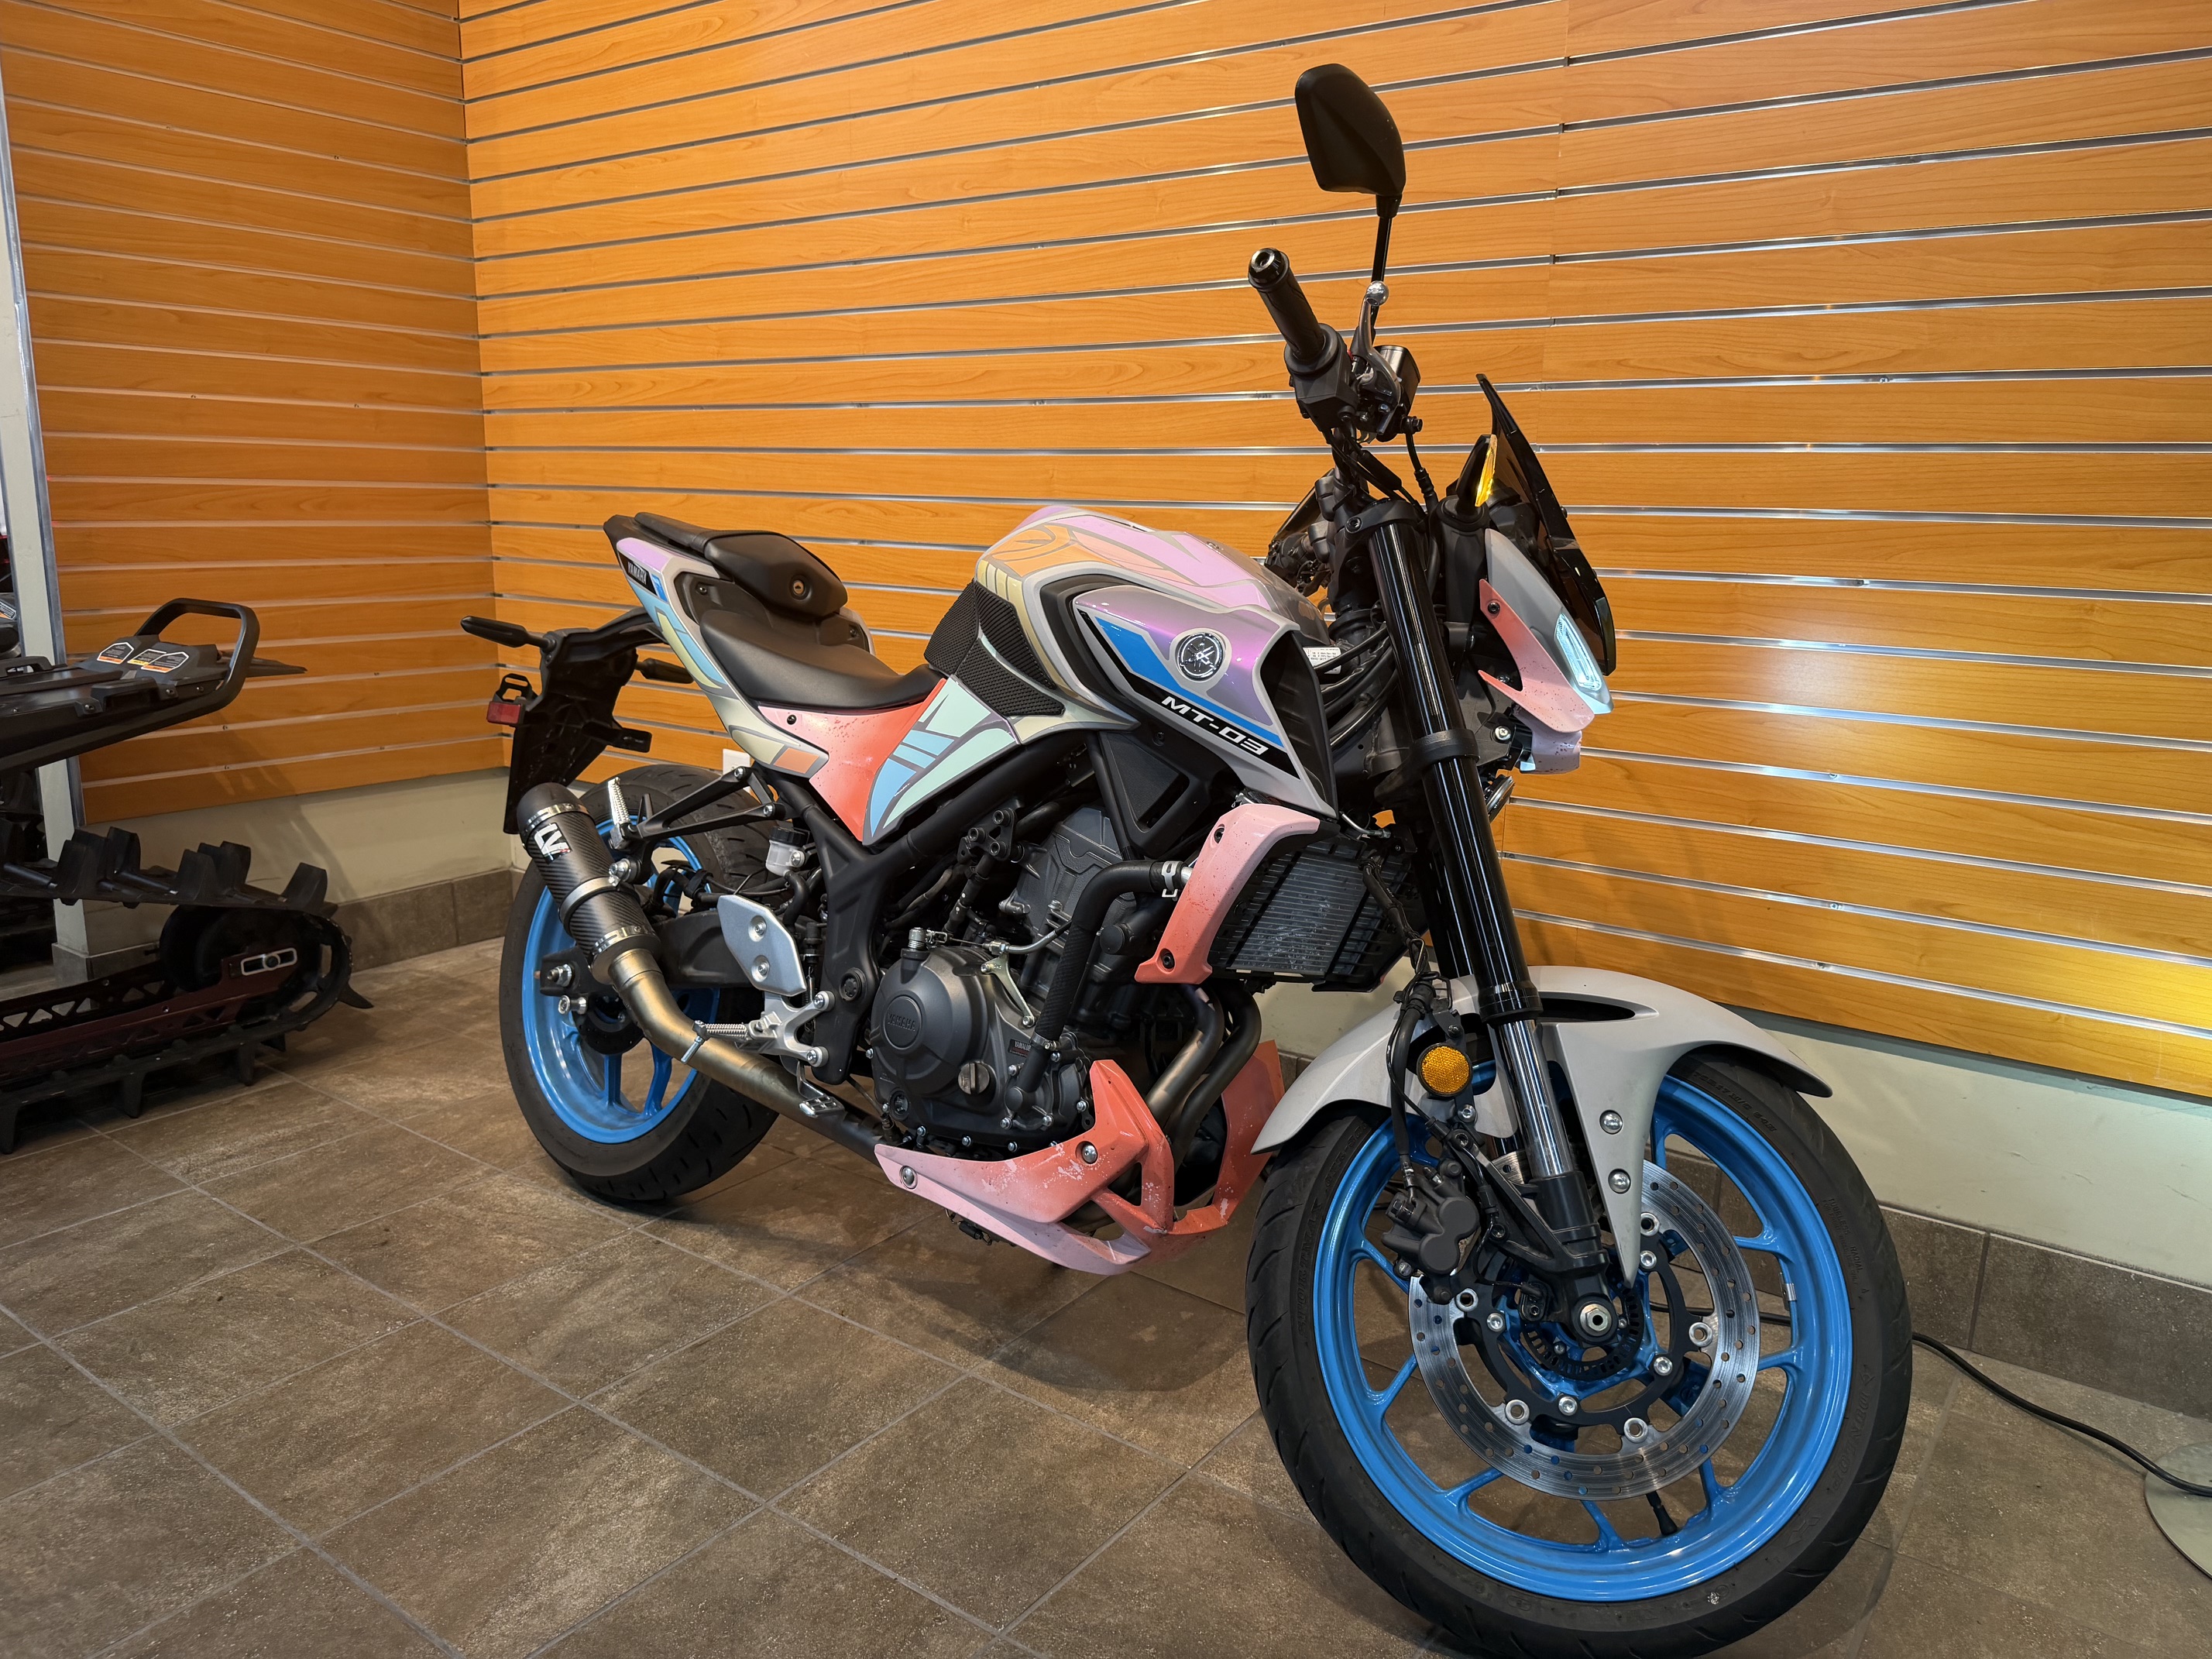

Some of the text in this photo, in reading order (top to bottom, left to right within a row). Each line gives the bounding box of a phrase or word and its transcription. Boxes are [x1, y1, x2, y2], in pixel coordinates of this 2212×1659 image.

[628, 561, 647, 585] YAMAHA
[1162, 696, 1269, 755] MT-03
[887, 1012, 915, 1032] YAMAHA
[1015, 1040, 1031, 1052] YAMALUB
[1828, 1198, 1863, 1273] TUBELESS RADIAL
[1832, 1392, 1870, 1491] DUNLOP
